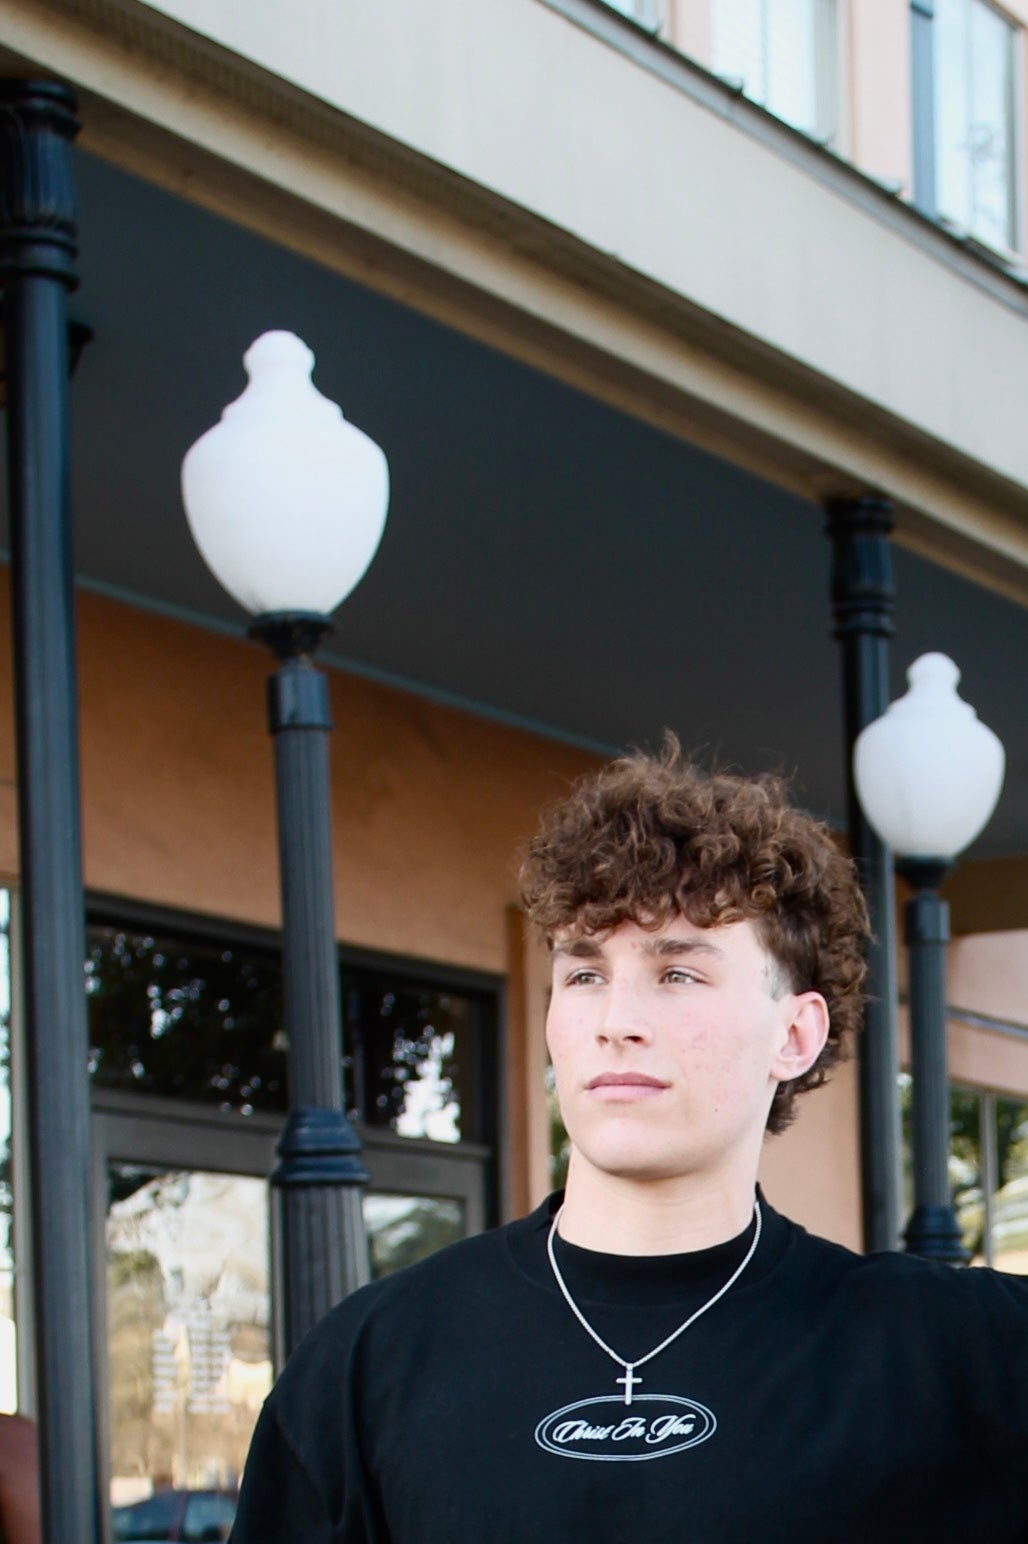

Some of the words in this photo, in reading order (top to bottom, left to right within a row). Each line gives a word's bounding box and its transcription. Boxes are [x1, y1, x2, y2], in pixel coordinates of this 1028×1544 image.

[552, 1420, 615, 1443] Christ
[611, 1417, 647, 1441] In
[645, 1414, 696, 1443] You
